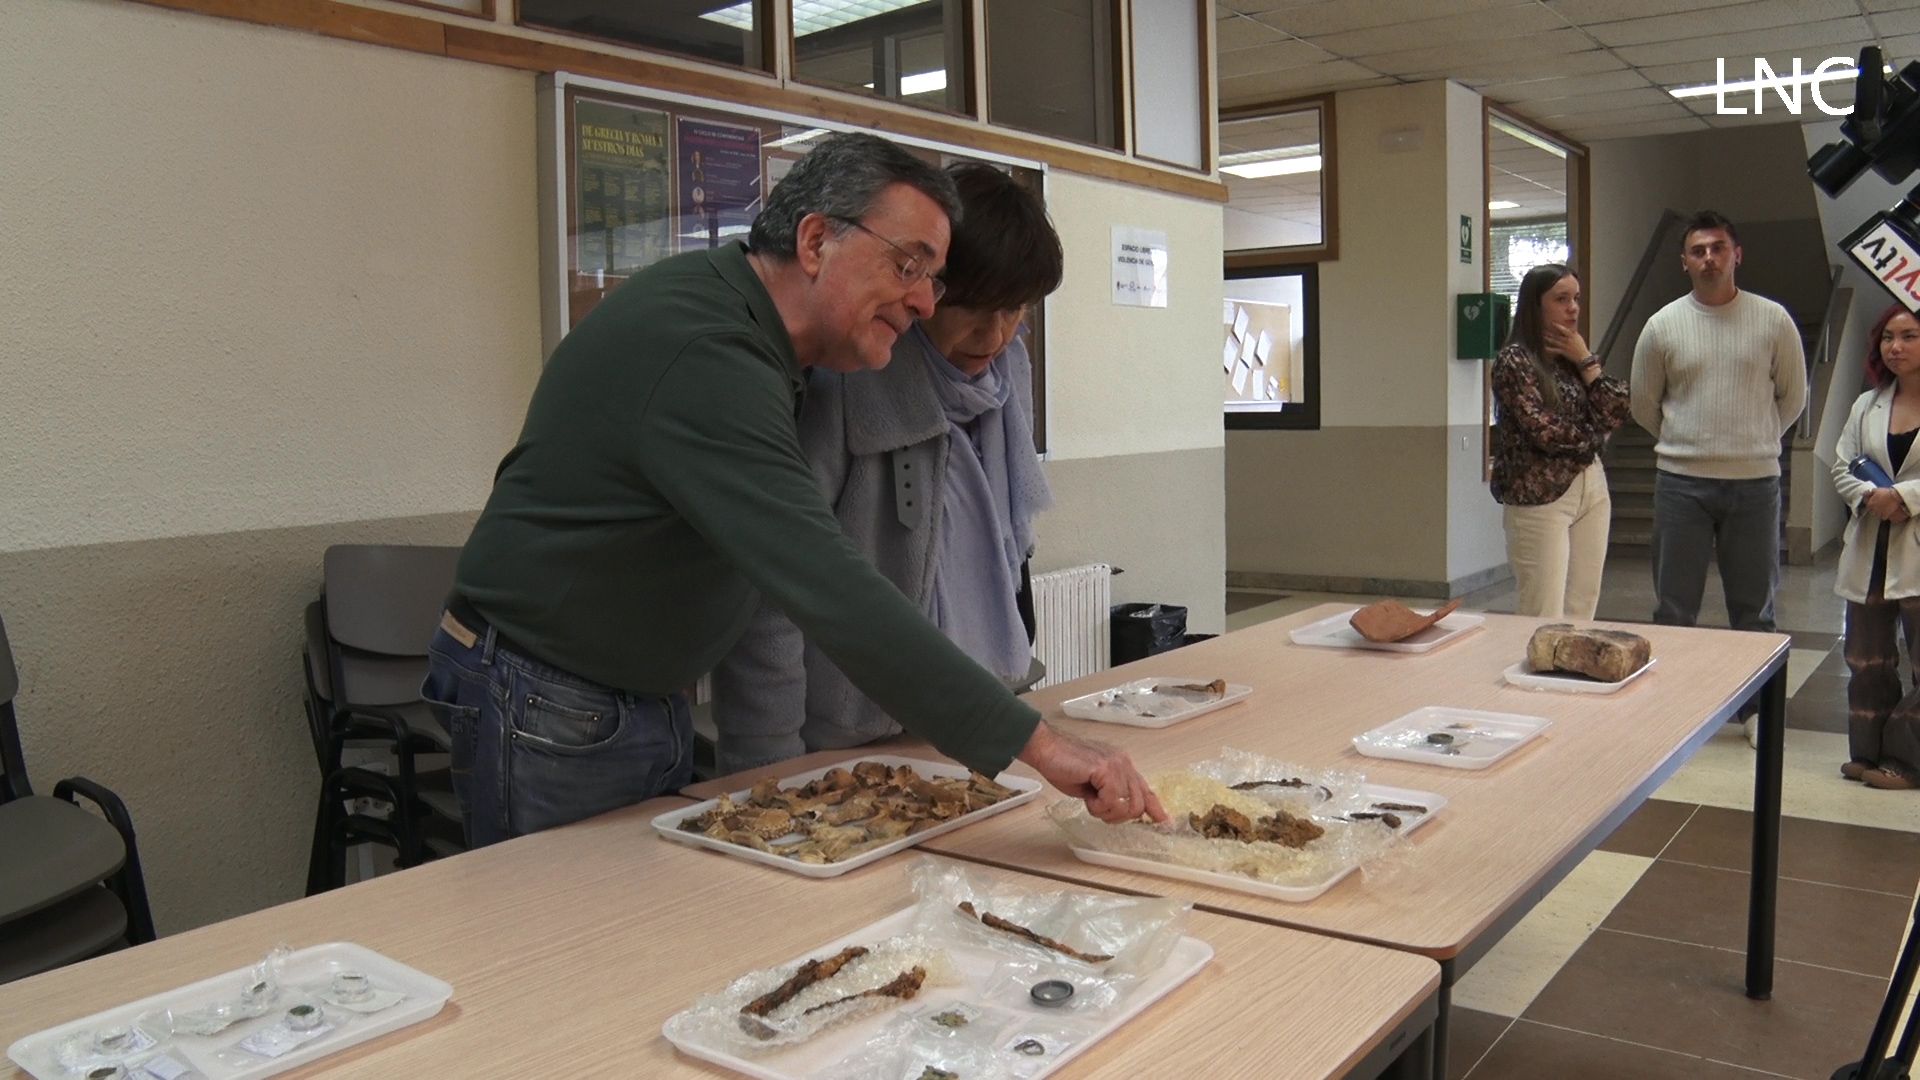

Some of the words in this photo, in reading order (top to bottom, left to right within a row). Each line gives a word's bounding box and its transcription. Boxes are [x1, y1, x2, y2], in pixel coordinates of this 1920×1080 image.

[594, 127, 624, 142] GRECIA
[582, 138, 626, 155] NUESTROS
[1121, 243, 1139, 253] ESPACIO
